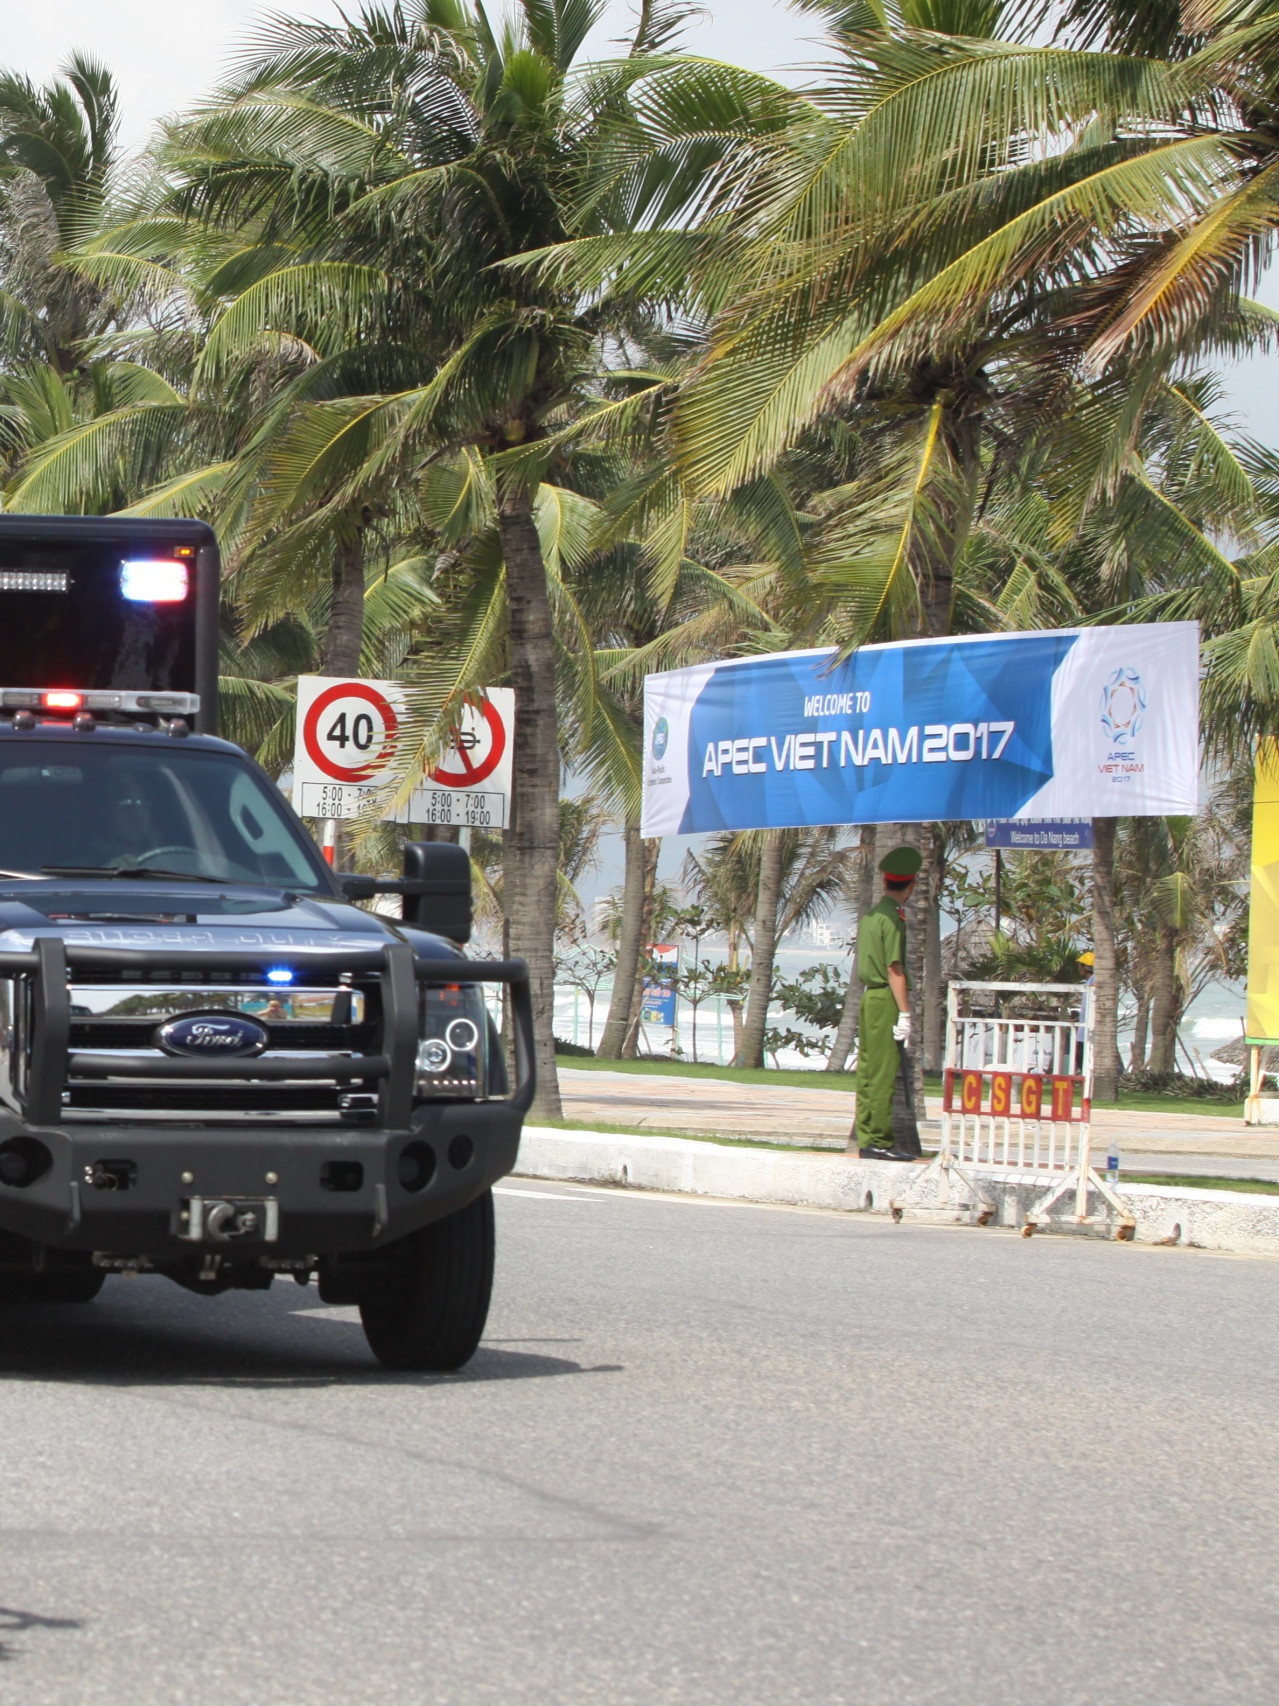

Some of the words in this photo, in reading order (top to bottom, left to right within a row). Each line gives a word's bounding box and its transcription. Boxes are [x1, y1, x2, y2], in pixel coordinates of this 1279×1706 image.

[803, 692, 854, 717] WELCOME
[855, 691, 871, 714] TO
[326, 712, 374, 751] 40
[701, 737, 768, 778] APEC
[770, 731, 837, 772] VIET
[839, 725, 920, 768] NAM
[921, 720, 1016, 764] 2017
[1106, 752, 1135, 761] APEC
[1097, 764, 1120, 773] VIET
[1121, 764, 1144, 773] NAM
[322, 786, 343, 802] 5:00
[431, 792, 452, 808] 5:00
[465, 794, 486, 809] 7:00
[316, 802, 343, 817] 16:00
[426, 808, 452, 823] 16:00
[465, 810, 491, 825] 19:00
[1010, 831, 1034, 844] Welcome
[1034, 832, 1040, 844] to
[1049, 831, 1062, 847] Nang
[1063, 832, 1080, 844] beach
[186, 1023, 244, 1046] Ford
[963, 1074, 1069, 1116] CSGT
